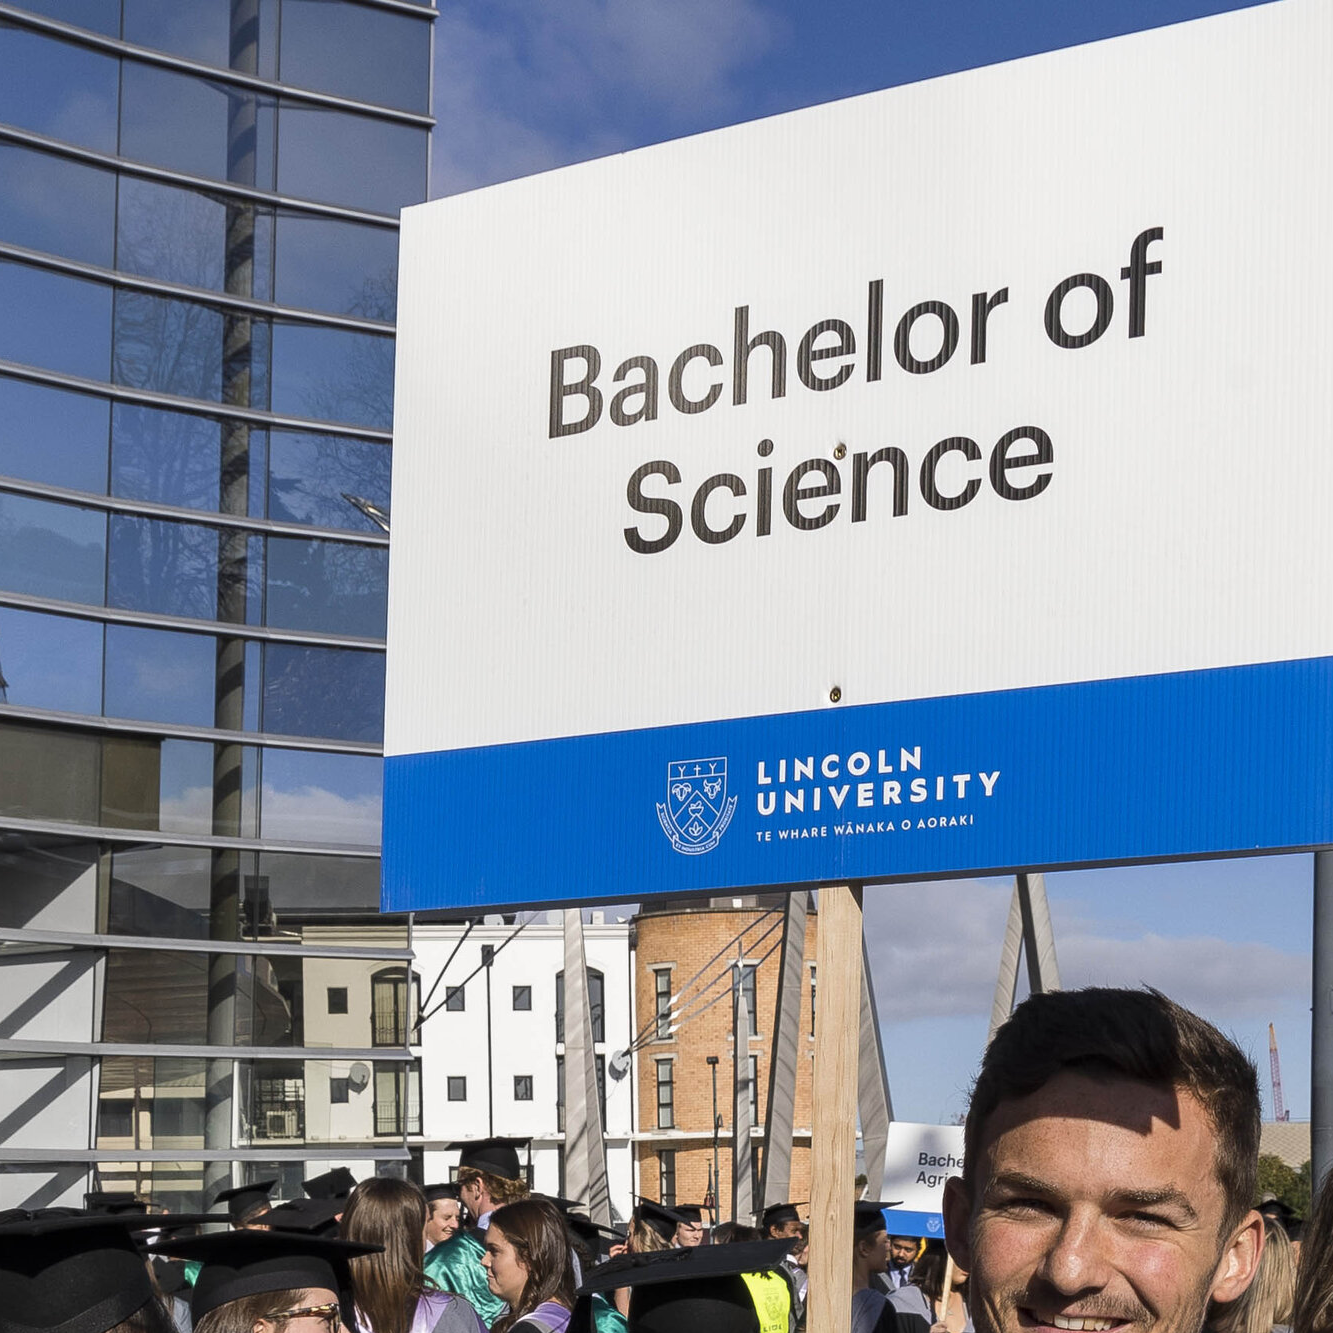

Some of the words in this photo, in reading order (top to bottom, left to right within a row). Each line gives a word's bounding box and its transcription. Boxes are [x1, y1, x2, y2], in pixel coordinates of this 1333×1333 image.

[548, 278, 1009, 440] Bachelor
[1043, 226, 1164, 350] of
[623, 425, 1054, 555] Science
[757, 745, 922, 785] LINCOLN
[757, 770, 1001, 815] UNIVERSITY
[756, 830, 773, 842] TE
[778, 826, 827, 841] WHARE
[833, 821, 895, 836] WĀNAKA
[901, 819, 912, 831] O
[916, 814, 974, 829] AORAKI
